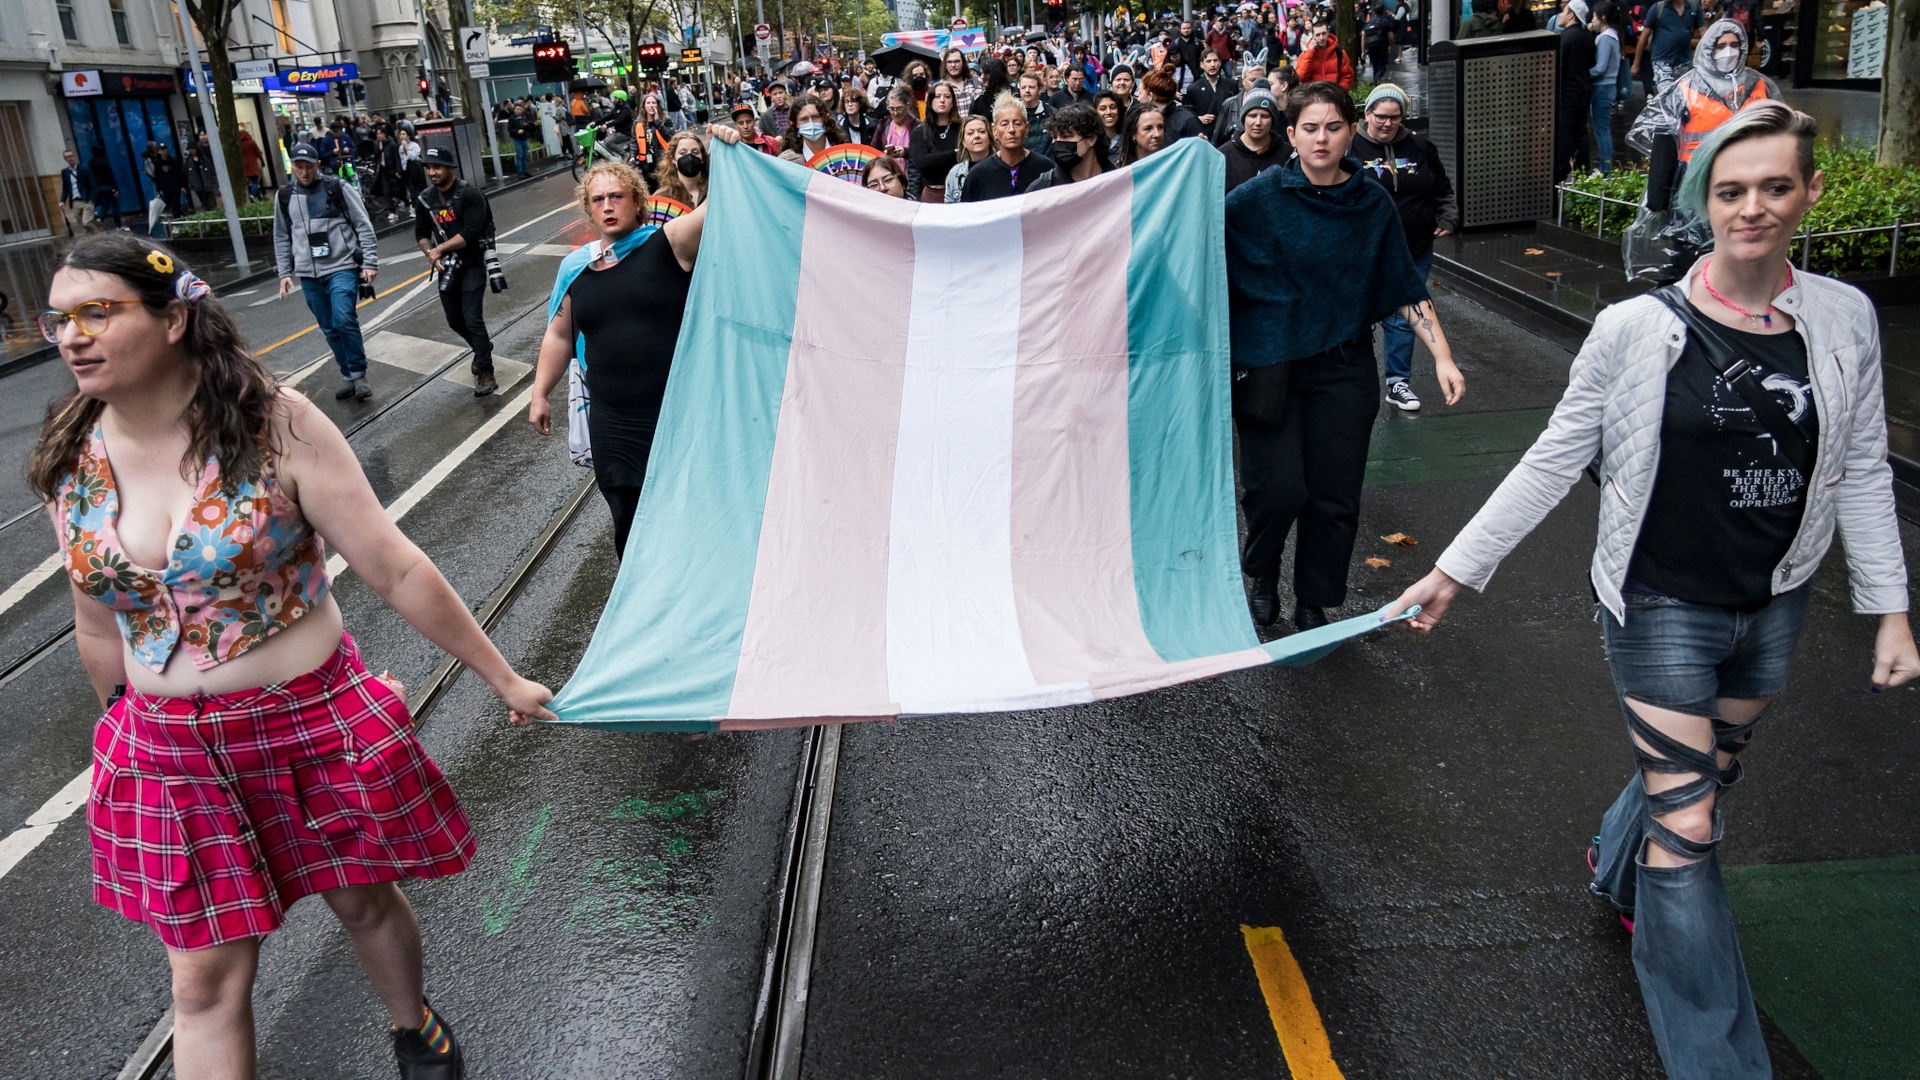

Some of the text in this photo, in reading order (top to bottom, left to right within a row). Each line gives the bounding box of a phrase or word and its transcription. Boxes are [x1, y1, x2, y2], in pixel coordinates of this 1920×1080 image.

[591, 60, 614, 68] CHEAP
[300, 67, 344, 82] EzyMart
[1723, 469, 1740, 477] BE
[1745, 469, 1772, 477] THE
[1735, 475, 1803, 485] BURIED IN
[1730, 483, 1804, 493] THE HEART
[1743, 491, 1789, 500] OF THE
[1730, 497, 1798, 507] OPPRESSOR
